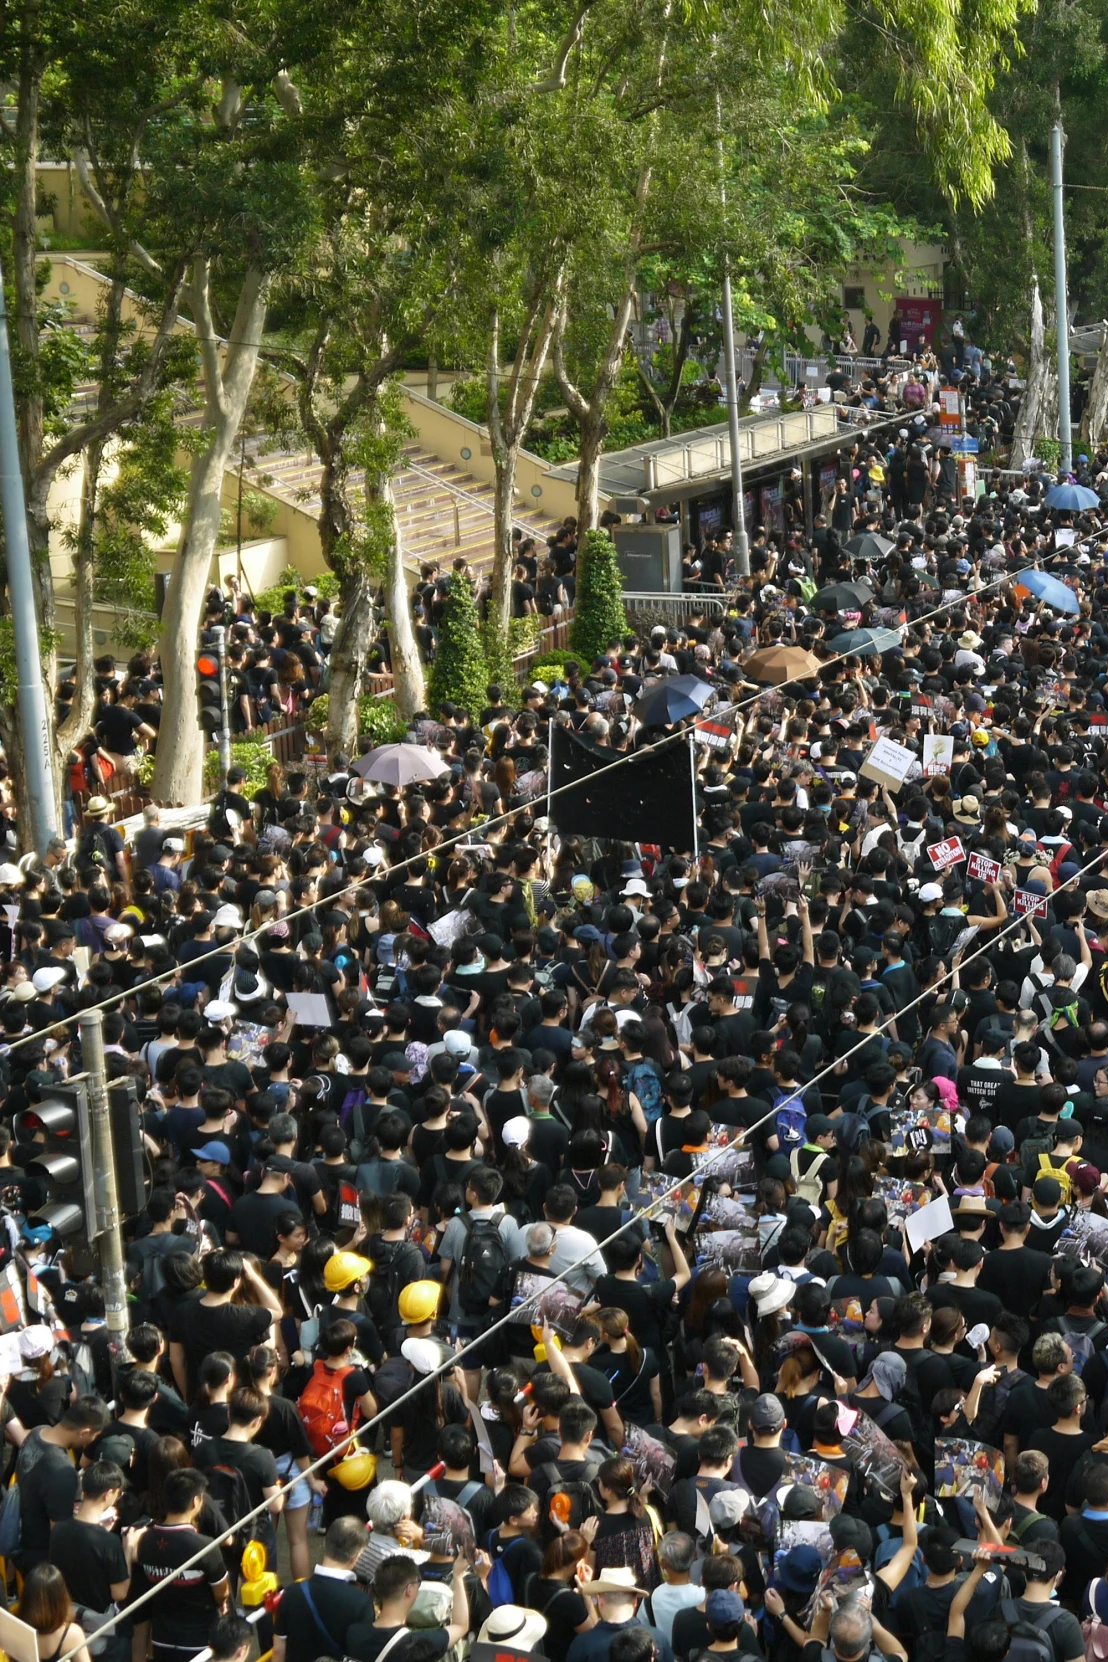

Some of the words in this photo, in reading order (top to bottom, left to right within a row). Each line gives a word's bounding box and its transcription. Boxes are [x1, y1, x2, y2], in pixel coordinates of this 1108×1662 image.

[42, 719, 51, 770] 225A
[934, 842, 950, 858] NO
[976, 856, 994, 868] STOP
[971, 862, 996, 877] KILLING
[978, 872, 987, 880] US
[1022, 893, 1040, 902] STOP
[970, 1080, 983, 1088] THAT
